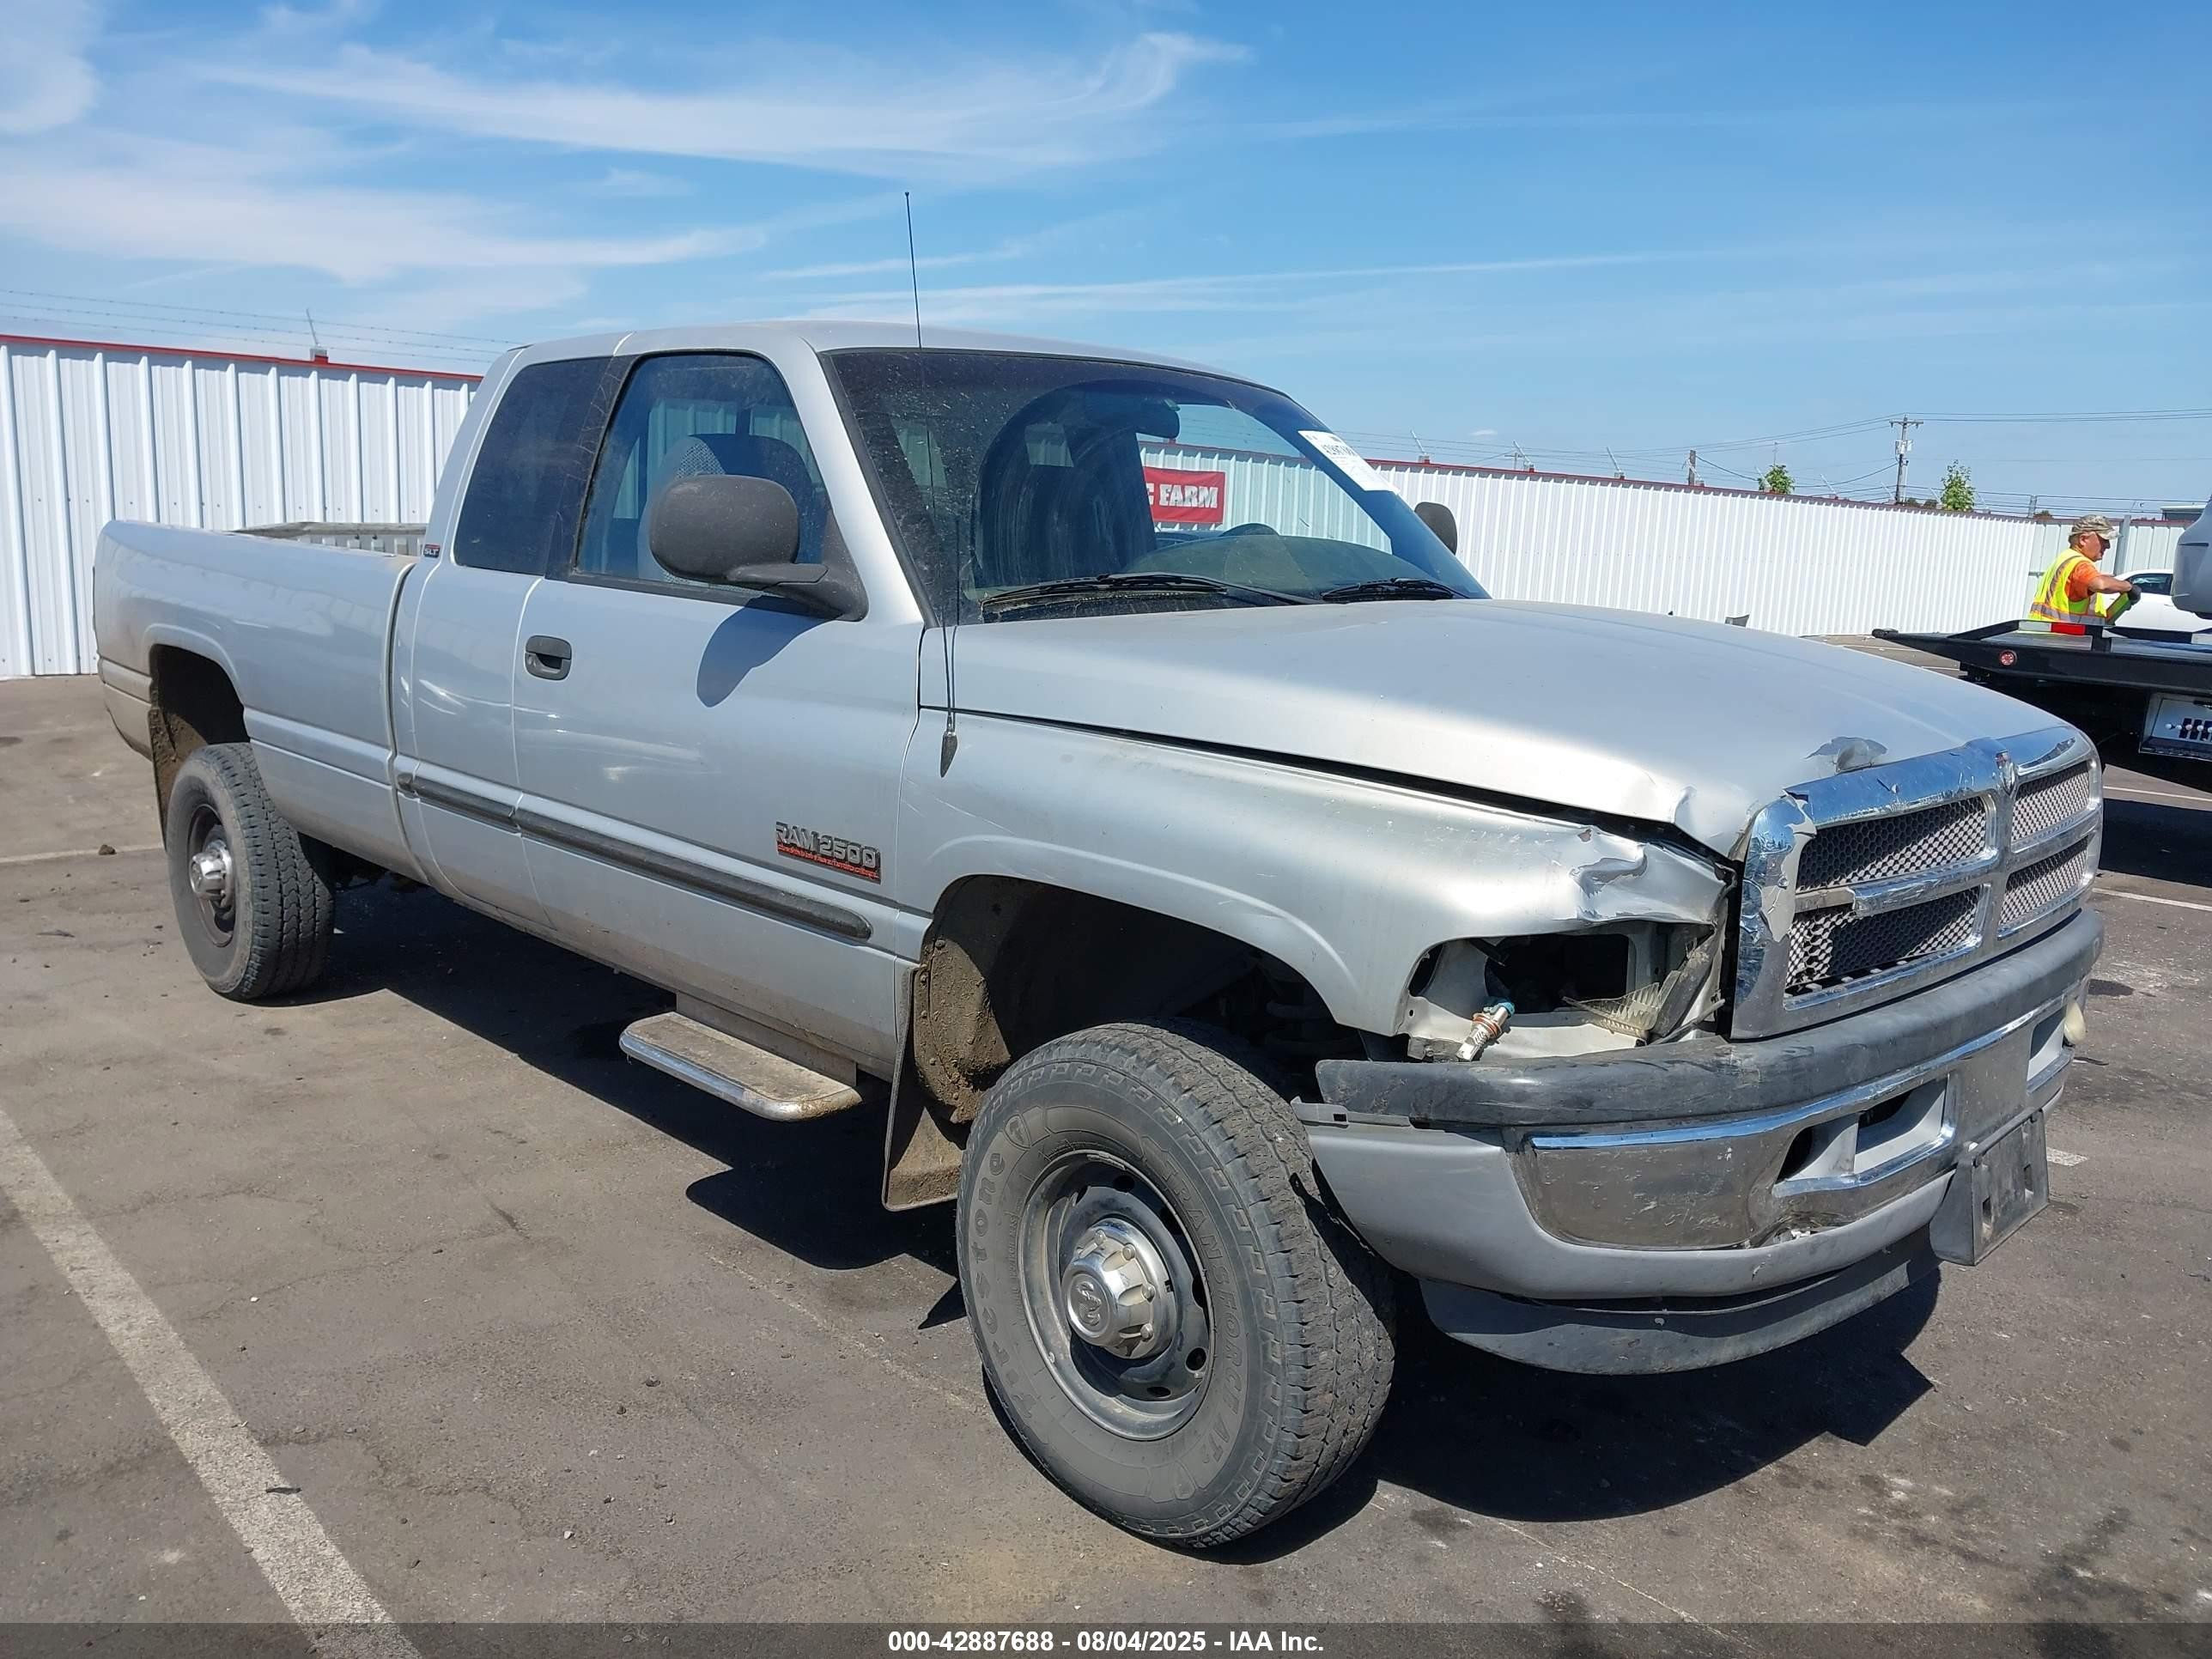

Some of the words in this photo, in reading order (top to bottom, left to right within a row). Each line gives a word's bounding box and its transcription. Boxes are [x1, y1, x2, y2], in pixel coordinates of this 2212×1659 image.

[1159, 483, 1218, 508] FARM
[776, 821, 819, 852] RAM
[819, 835, 879, 868] 2500
